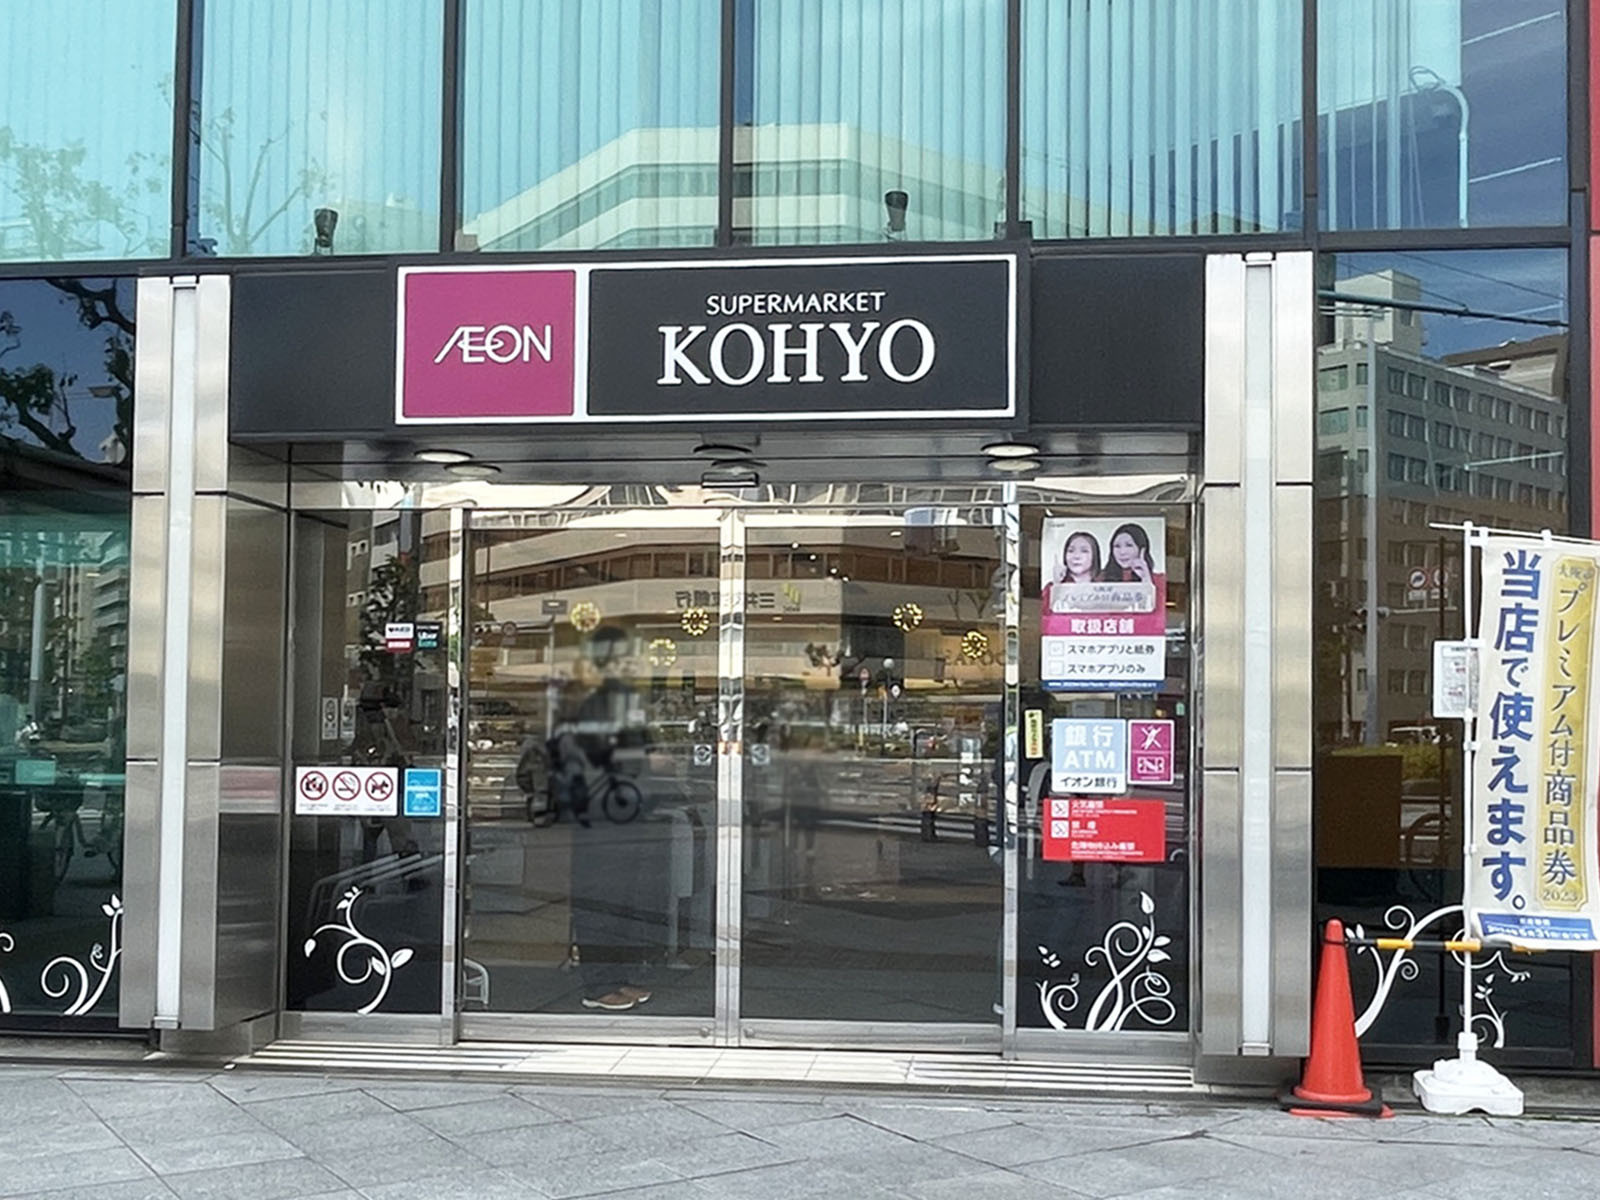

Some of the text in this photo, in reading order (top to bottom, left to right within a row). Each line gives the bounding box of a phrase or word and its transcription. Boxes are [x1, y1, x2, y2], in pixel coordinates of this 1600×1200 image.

[706, 290, 886, 316] SUPERMARKET
[656, 318, 936, 388] KOHYO
[1070, 618, 1135, 634] 取扱店舗
[1067, 663, 1146, 675] スマホアプリのみ
[1064, 724, 1114, 747] 銀行
[1482, 549, 1542, 910] 当店で使えます。
[1542, 582, 1588, 886] プレミアム付商品券
[1063, 752, 1115, 769] ATM
[1060, 776, 1118, 789] イオン銀行
